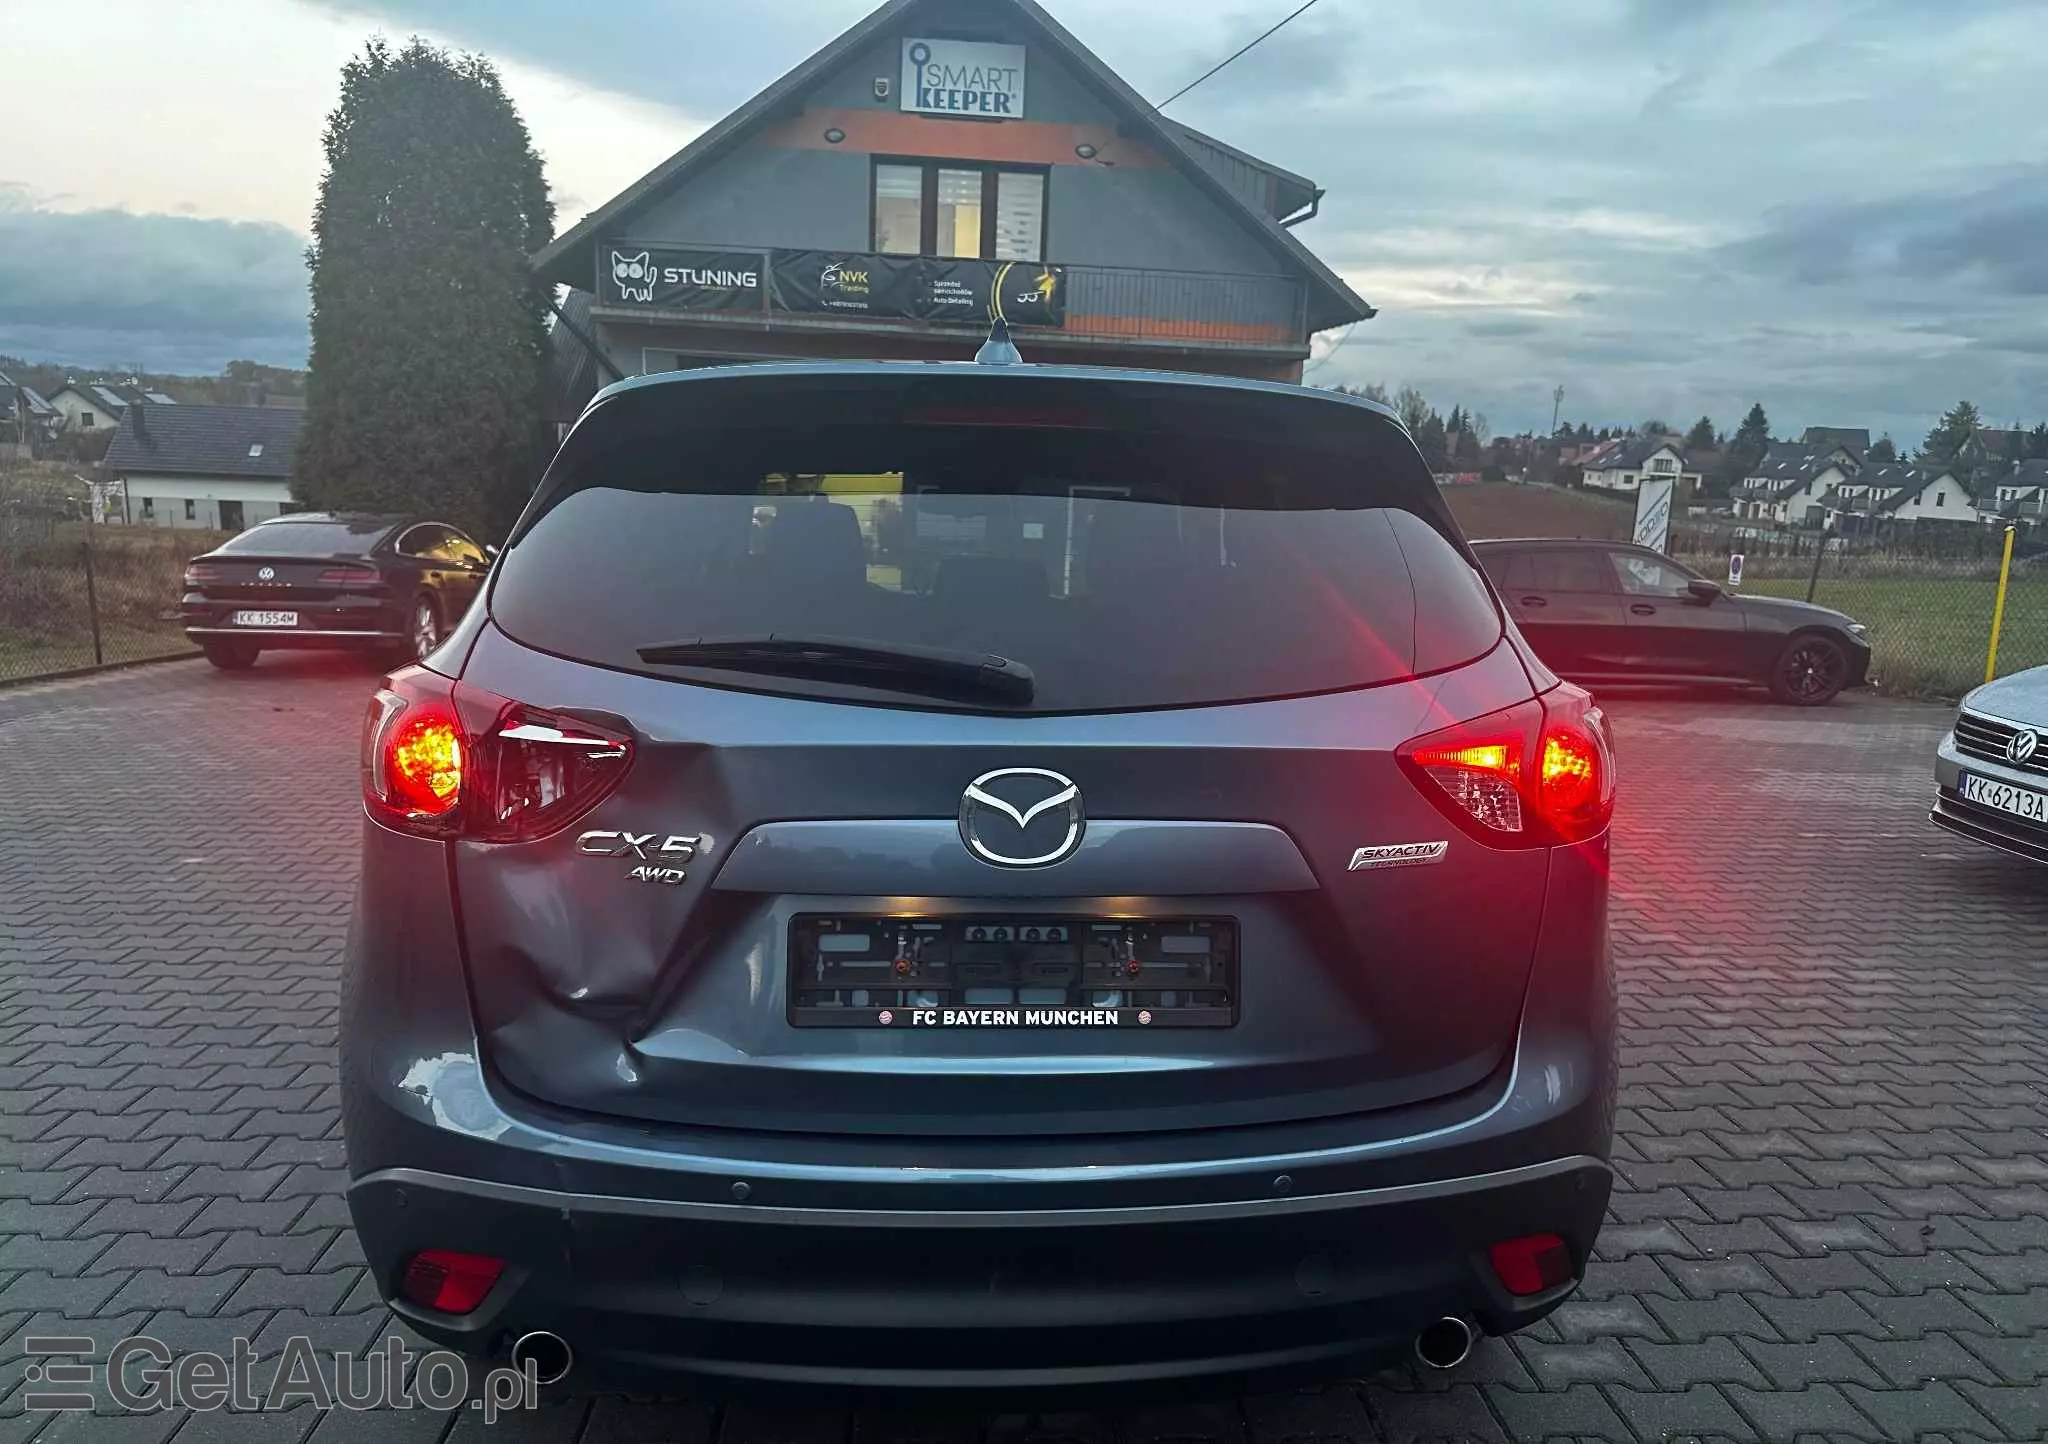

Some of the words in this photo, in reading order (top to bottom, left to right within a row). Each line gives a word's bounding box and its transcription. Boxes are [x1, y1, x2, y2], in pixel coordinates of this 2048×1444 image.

[927, 63, 1018, 92] SMART
[915, 87, 1011, 113] KEEPER
[664, 268, 757, 287] STUNING
[839, 271, 868, 282] NVK
[240, 612, 253, 623] KK
[260, 612, 295, 624] 1554M
[1968, 776, 1988, 804] KK
[1992, 785, 2044, 821] 6213A
[576, 830, 701, 863] CX-5
[1362, 844, 1440, 859] SKYACTIV
[624, 866, 686, 884] AWD
[912, 1010, 937, 1025] FC
[943, 1010, 1018, 1025] BAYERN
